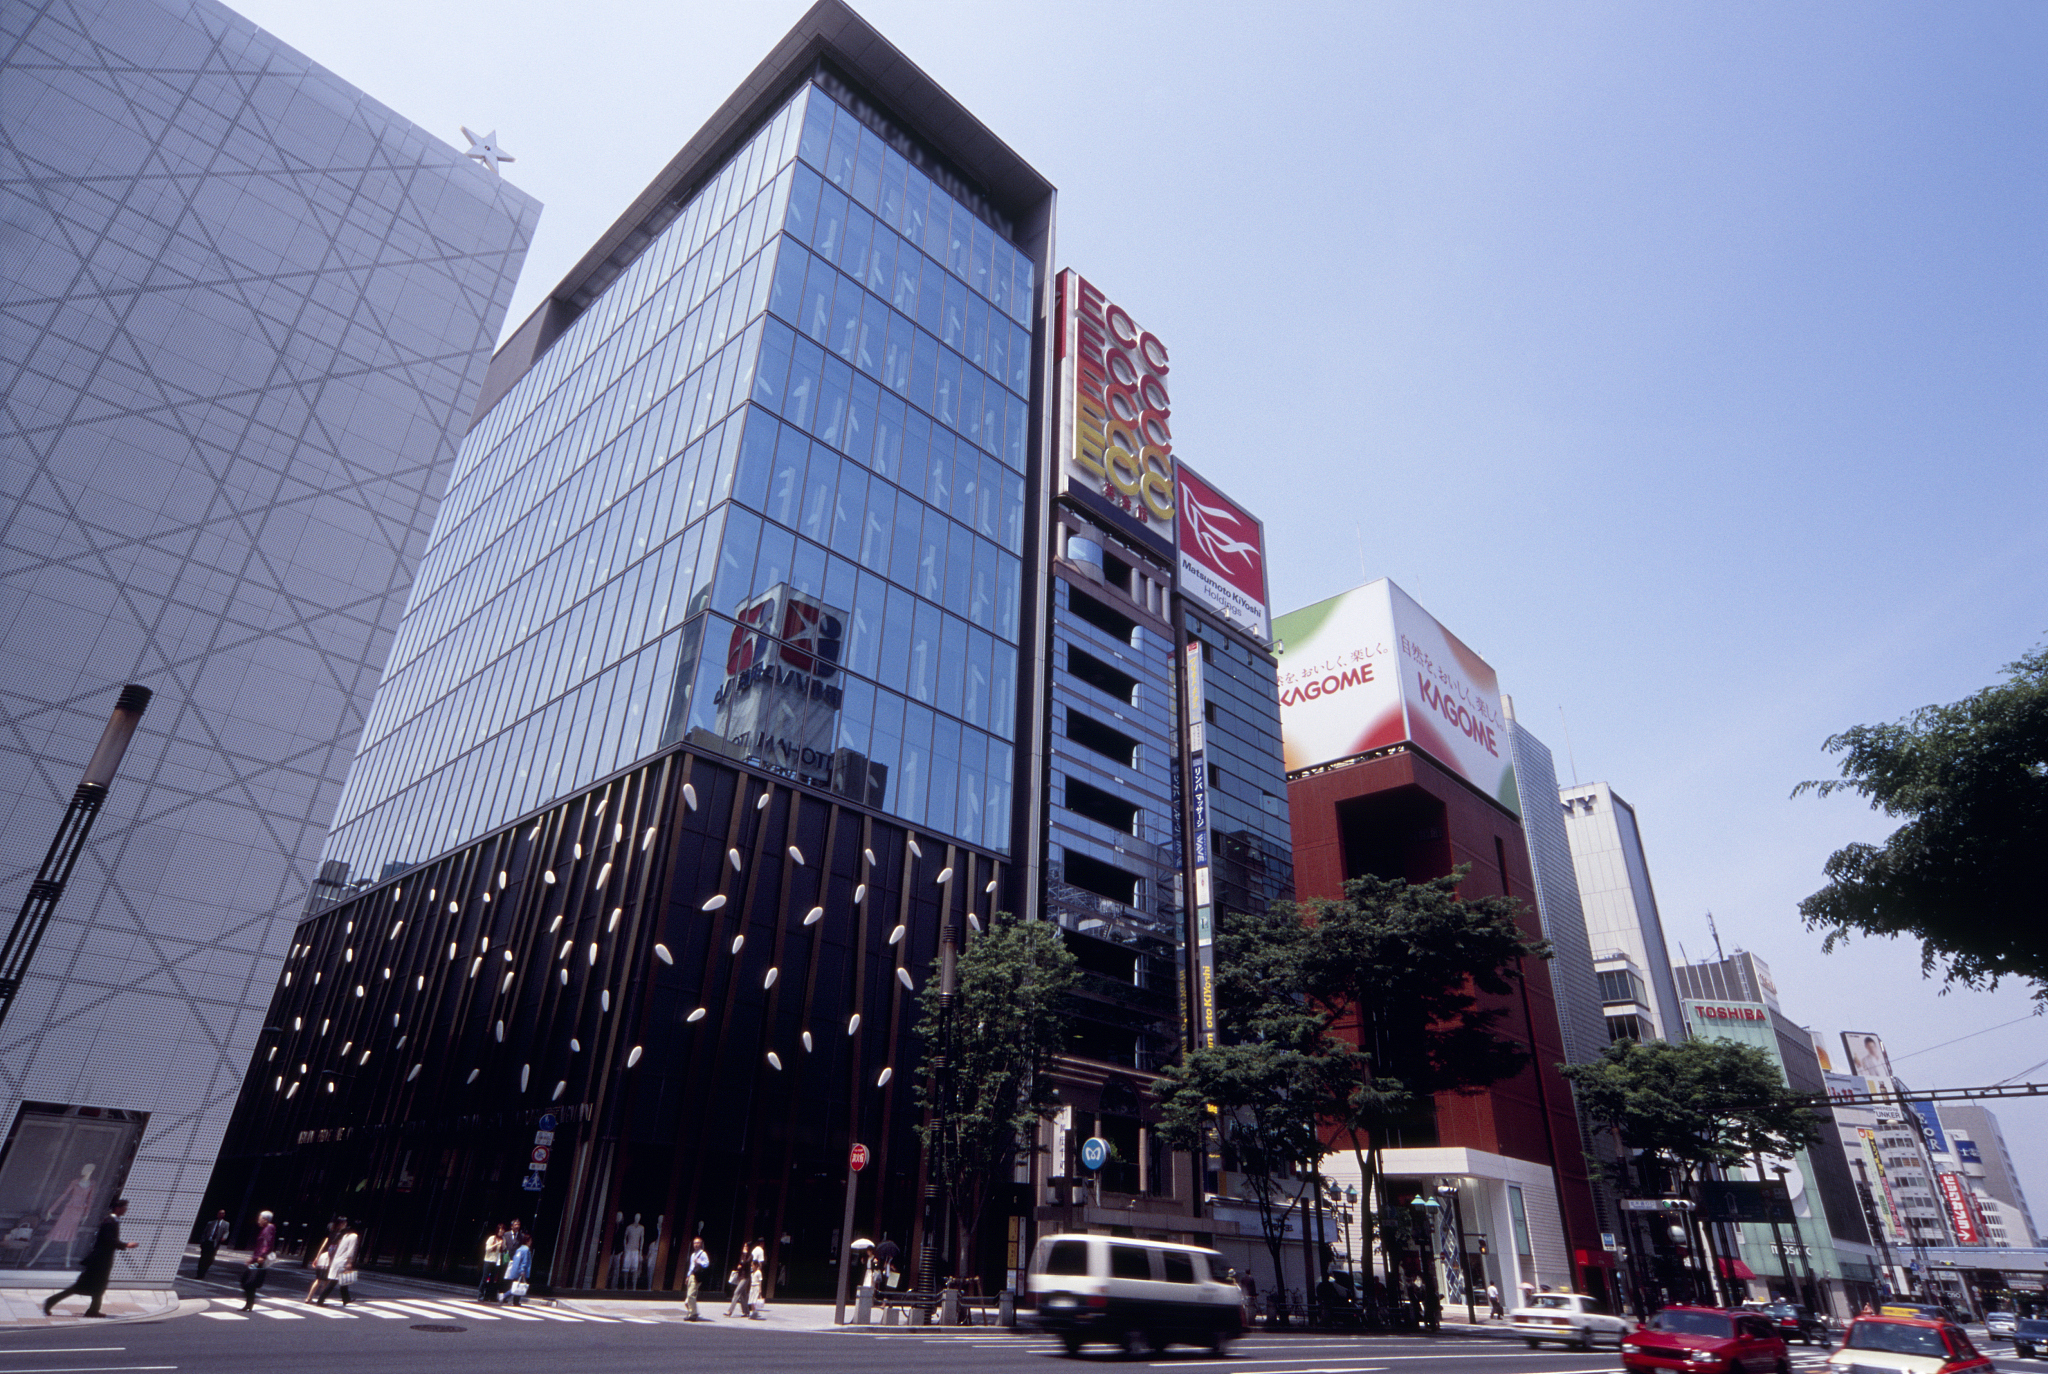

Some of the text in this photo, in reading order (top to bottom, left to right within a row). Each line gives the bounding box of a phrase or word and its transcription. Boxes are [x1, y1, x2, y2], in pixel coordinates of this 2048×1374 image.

[1075, 273, 1171, 376] ECC
[1075, 316, 1172, 420] ECC
[1075, 353, 1173, 456] ECC
[1072, 418, 1176, 521] ECC
[1182, 559, 1262, 618] Matsumoto KiYoshi
[1204, 585, 1242, 617] Holdings
[1417, 671, 1499, 758] KAGOME
[1194, 766, 1203, 792] リンパ
[1195, 793, 1205, 828] マッサージ
[1196, 833, 1205, 863] WAVE
[1202, 965, 1213, 1007] KiYoshi
[1694, 1006, 1767, 1021] TOSHIBA
[1876, 1110, 1901, 1119] UNKER
